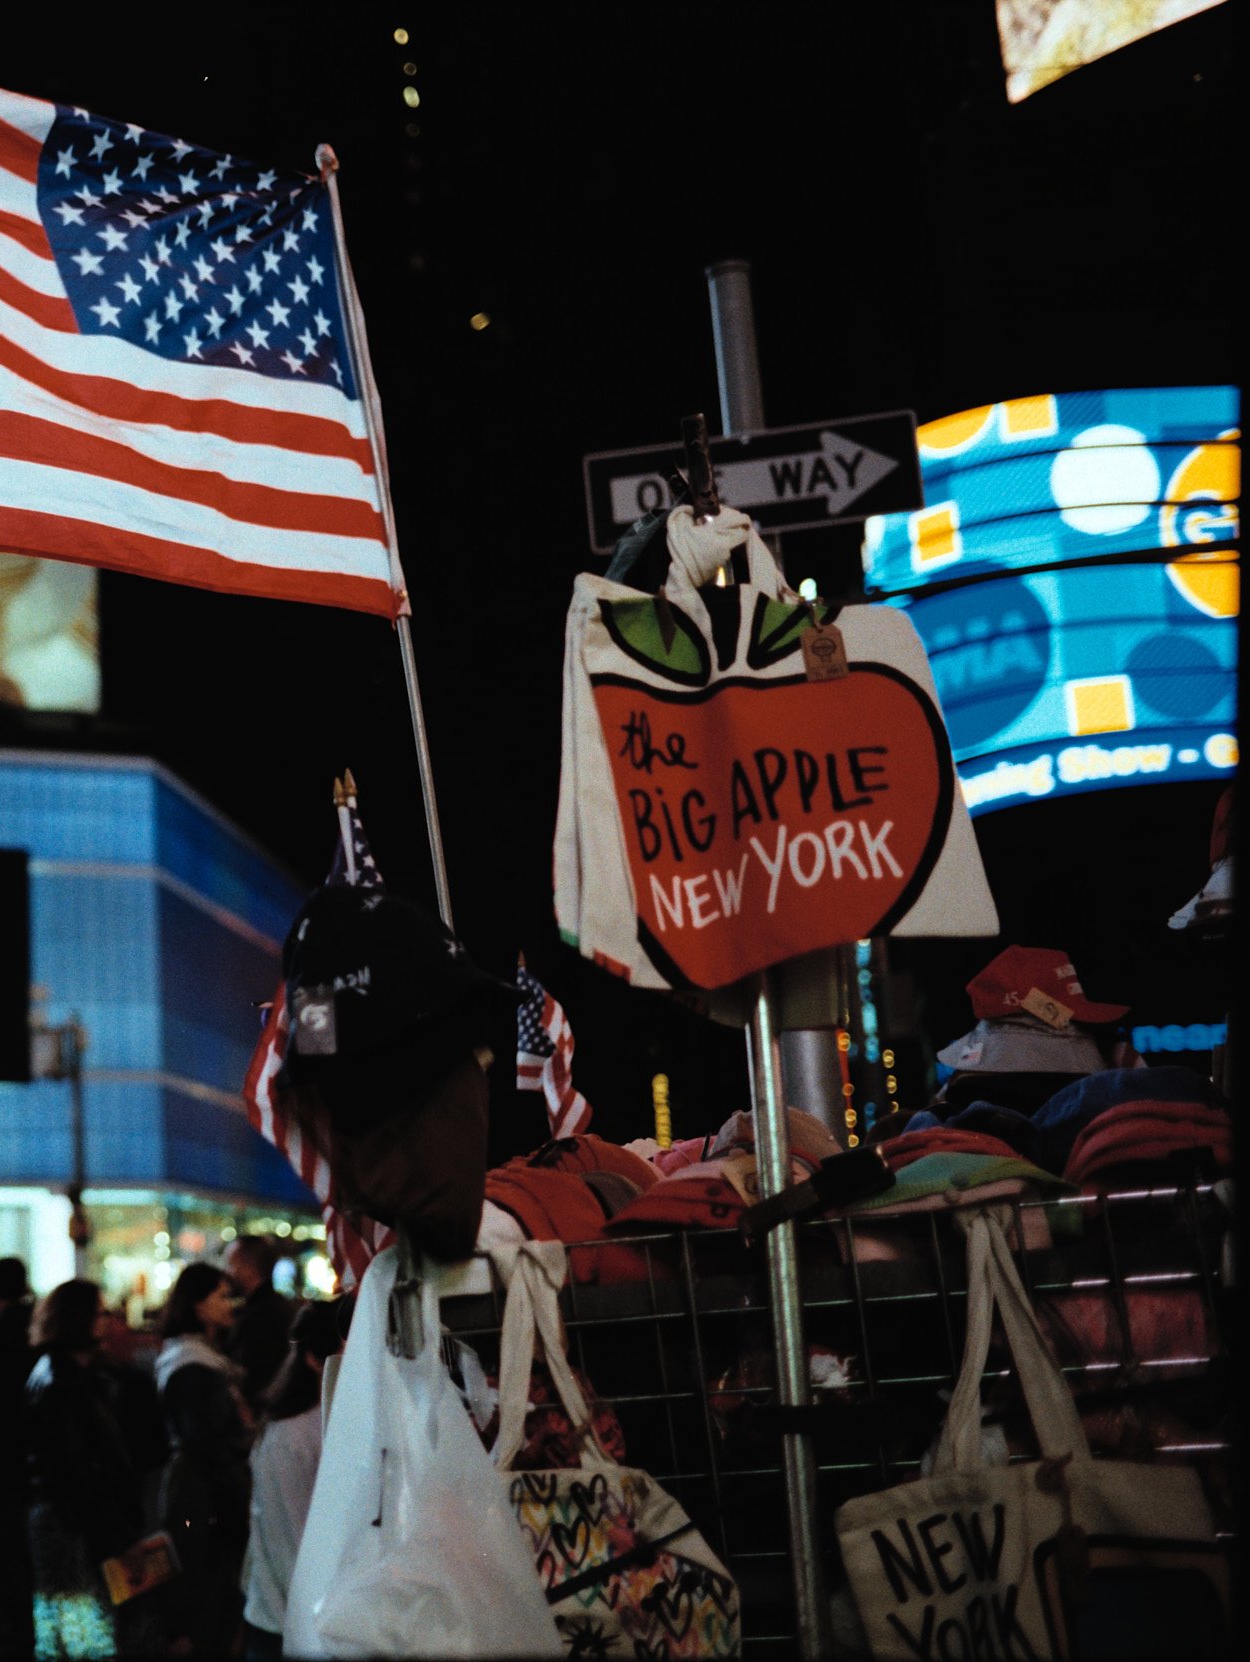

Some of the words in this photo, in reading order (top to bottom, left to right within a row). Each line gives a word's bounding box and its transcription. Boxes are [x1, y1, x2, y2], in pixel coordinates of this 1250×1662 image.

[768, 450, 865, 498] WAY
[619, 710, 699, 775] the
[1057, 745, 1172, 783] Show
[731, 746, 890, 841] APPLE
[648, 852, 749, 933] NEW
[749, 820, 905, 914] YORK
[869, 1503, 1006, 1604] NEW
[885, 1582, 1040, 1660] YORK
